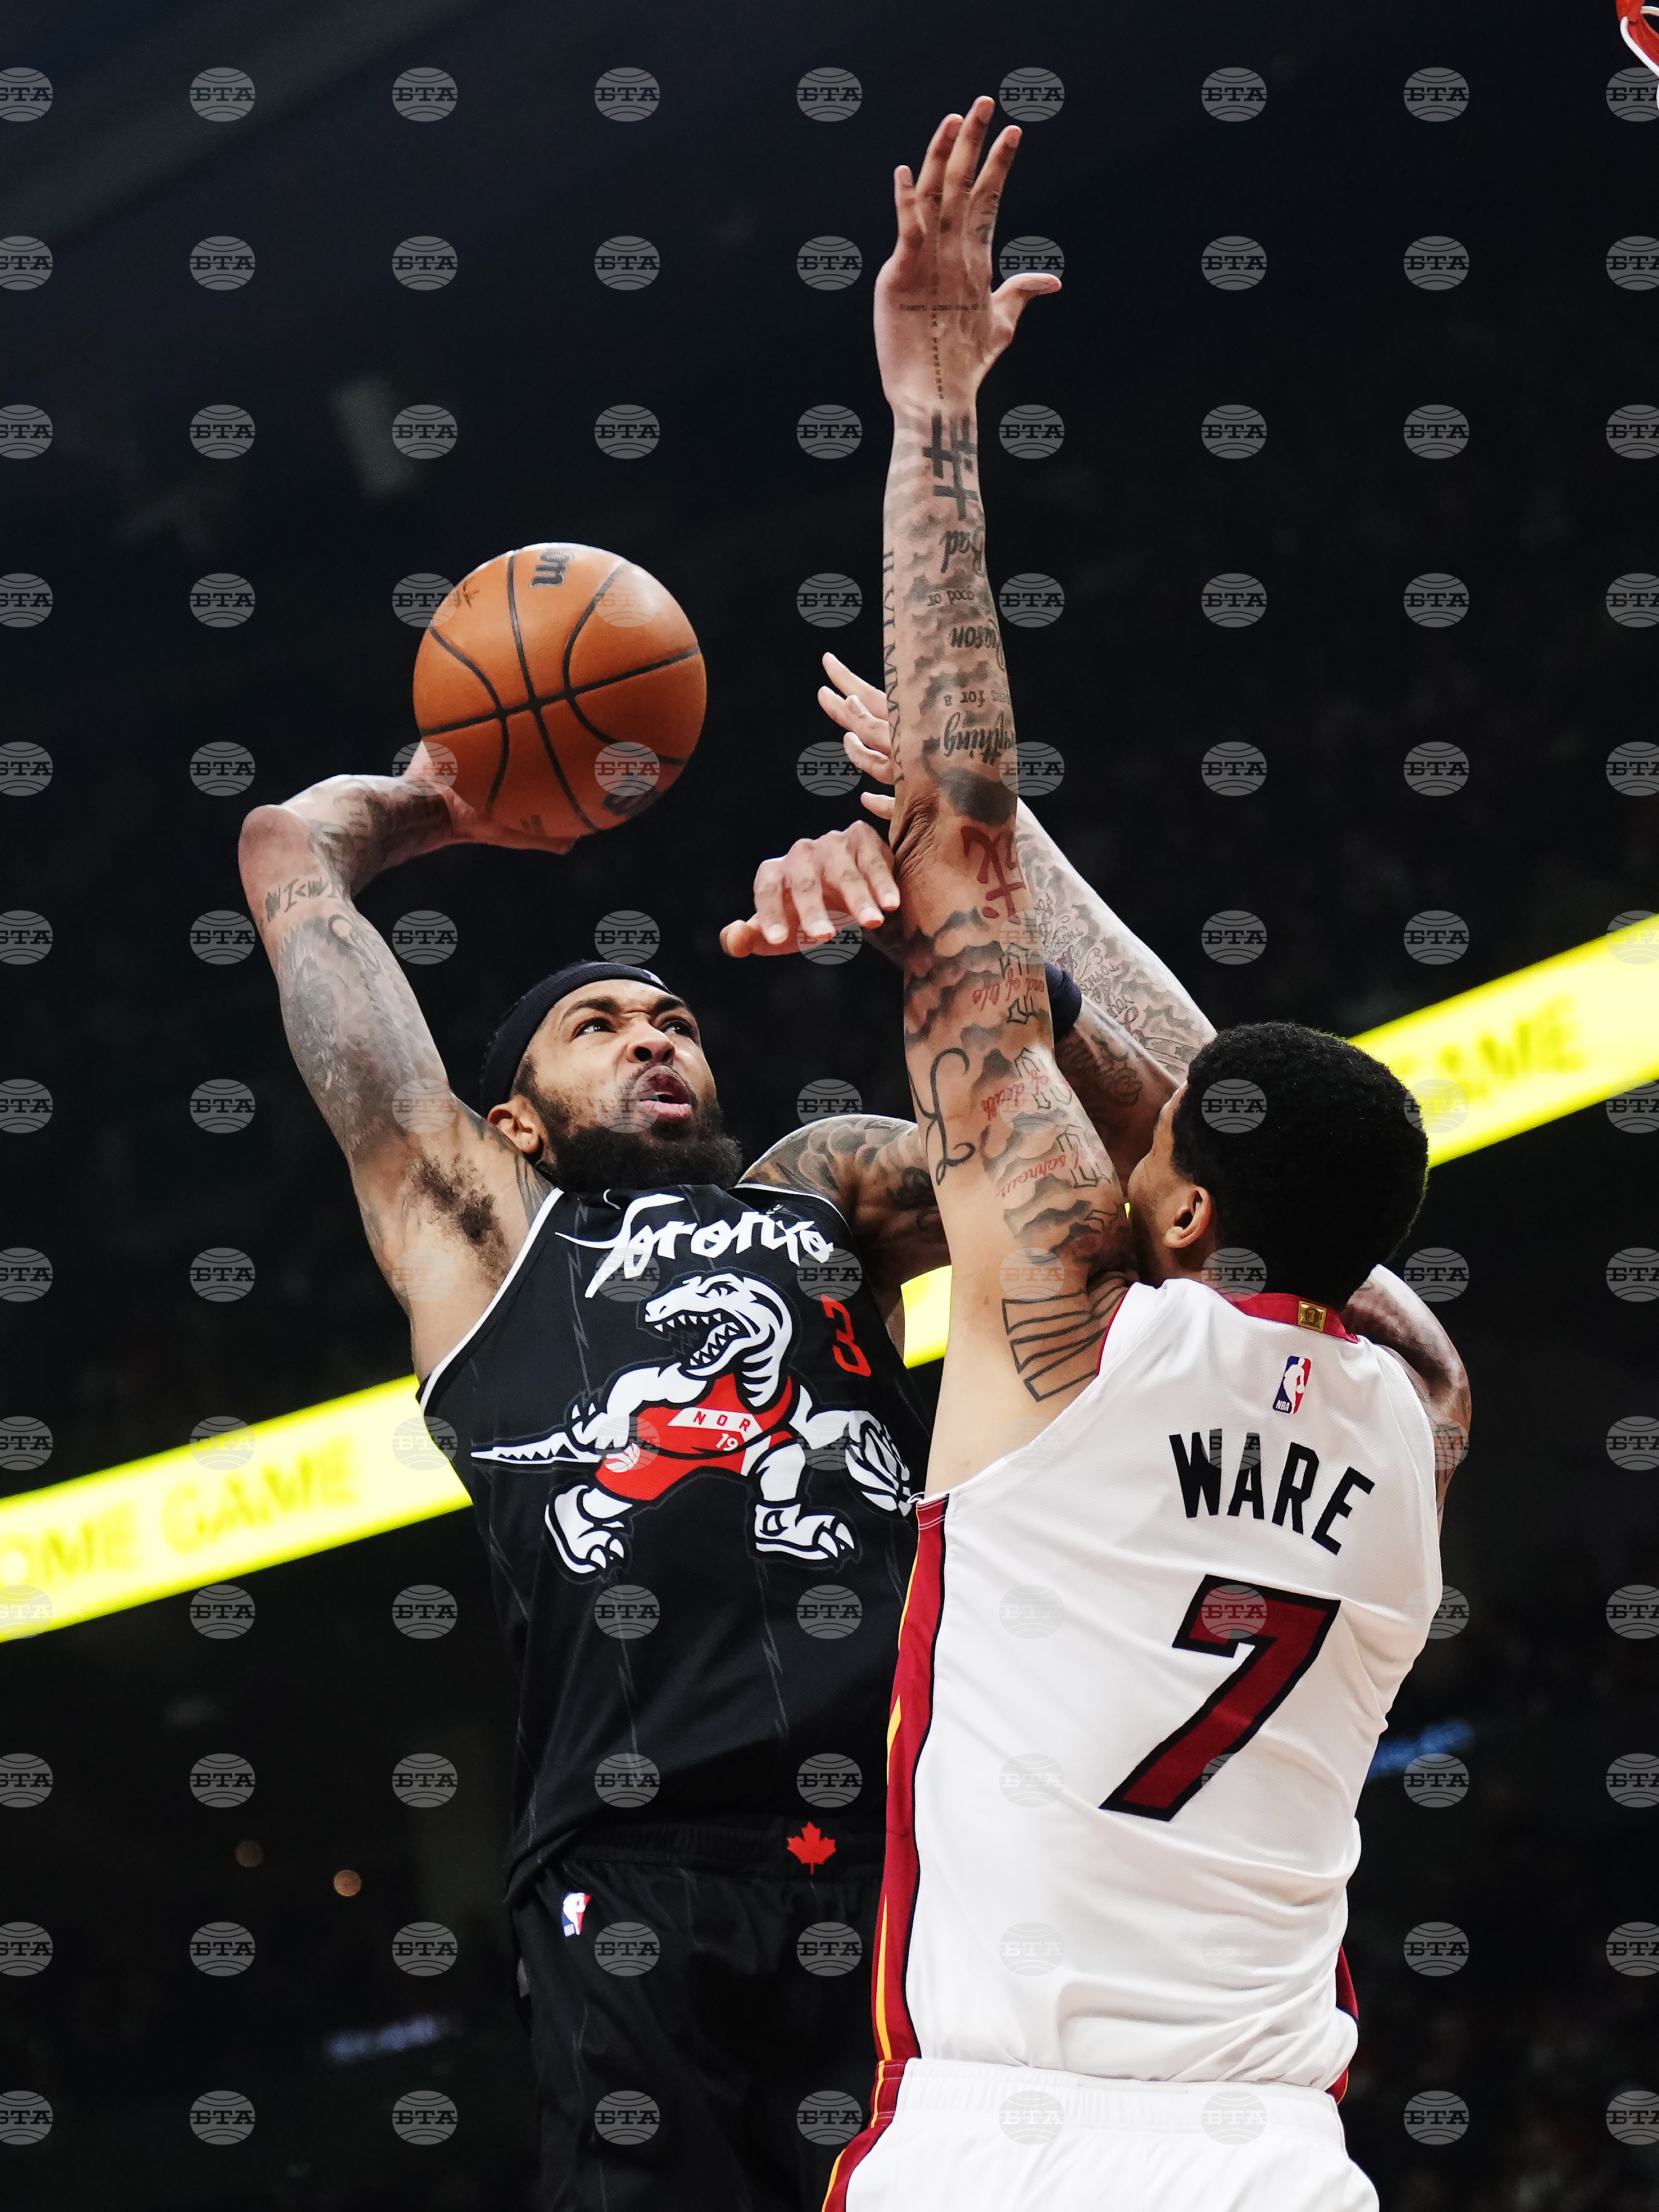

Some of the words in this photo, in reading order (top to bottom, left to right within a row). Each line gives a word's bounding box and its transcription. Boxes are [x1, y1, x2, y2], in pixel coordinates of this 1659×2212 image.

[1276, 1400, 1290, 1412] NBA
[1169, 1428, 1375, 1556] WARE
[1098, 1574, 1342, 1821] 7
